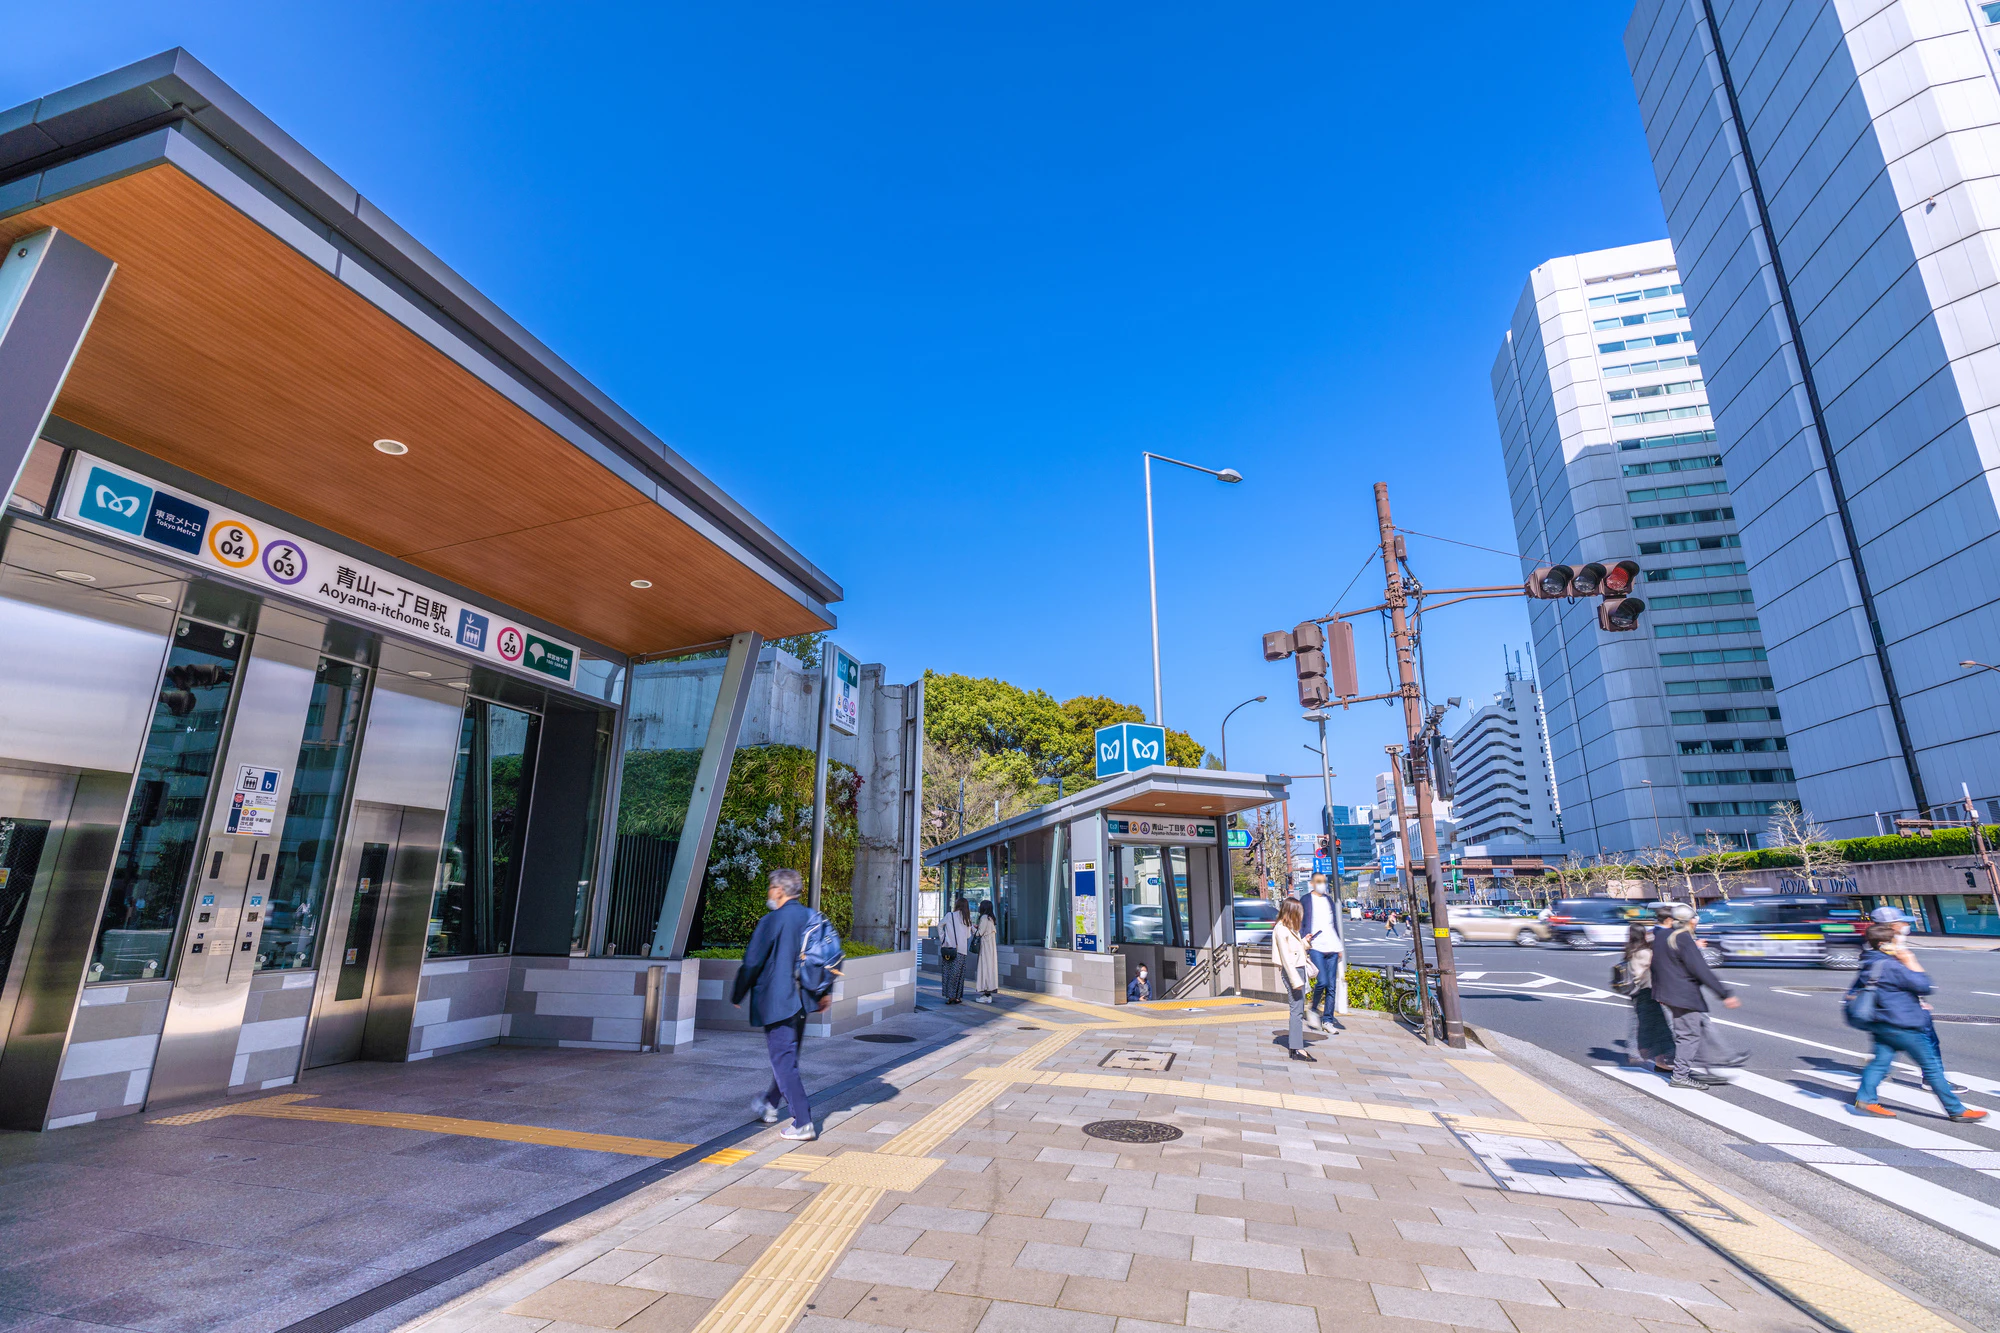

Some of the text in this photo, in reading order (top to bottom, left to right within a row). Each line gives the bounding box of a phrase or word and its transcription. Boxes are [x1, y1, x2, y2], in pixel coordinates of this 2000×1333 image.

[155, 509, 201, 531] 東京メトロ
[157, 518, 196, 537] Tokyo Metro
[230, 529, 243, 542] G
[221, 541, 244, 559] 04
[281, 547, 293, 561] Z
[273, 559, 295, 576] 03
[336, 565, 448, 623] 青山一丁目駅
[319, 583, 453, 639] Aoyama-itchome Sta.
[509, 633, 514, 642] E
[503, 642, 516, 655] 24
[265, 780, 272, 790] b
[1151, 823, 1186, 832] 青山一丁目駅
